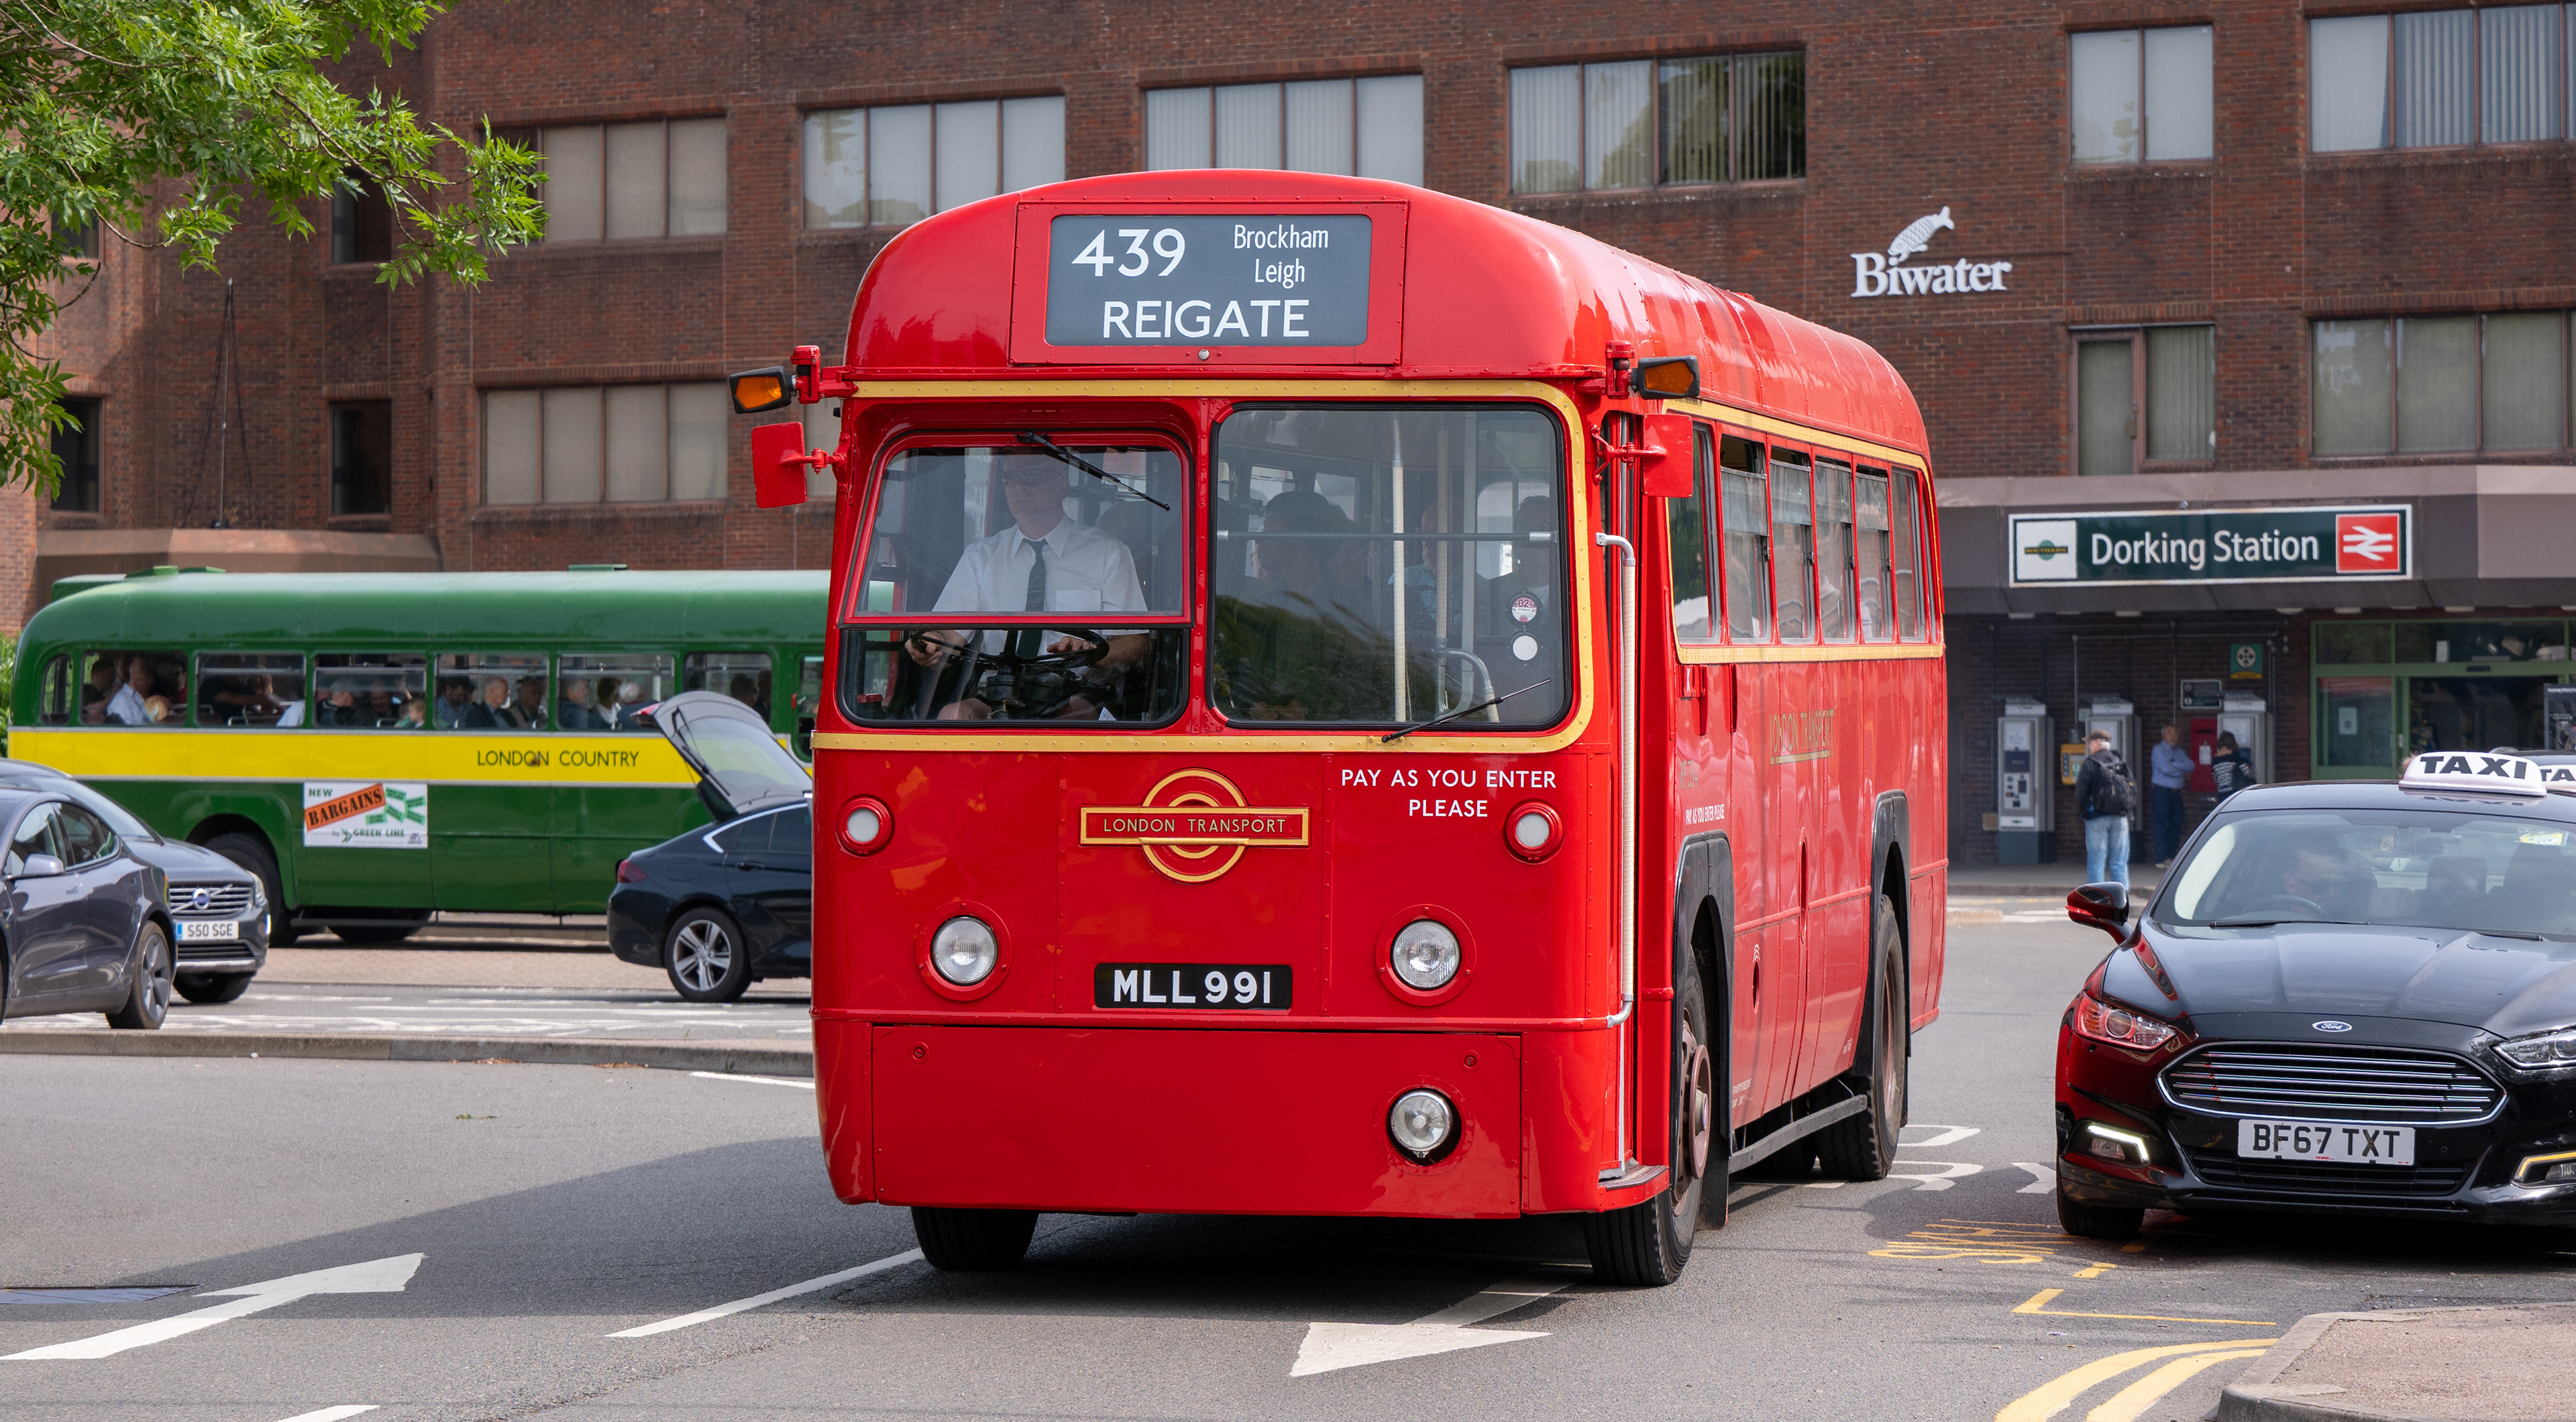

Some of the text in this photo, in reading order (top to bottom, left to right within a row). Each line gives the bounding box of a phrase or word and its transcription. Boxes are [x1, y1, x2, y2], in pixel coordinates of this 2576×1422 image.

[1071, 224, 1329, 277] 439 Brockham
[1254, 258, 1305, 290] Leigh
[1849, 252, 2013, 298] Biwater
[1103, 299, 1310, 339] REIGATE
[2092, 529, 2319, 571] Dorking Station
[1769, 708, 1834, 765] LONDON TRANSPORT
[477, 750, 639, 767] LONDON COUNTRY
[2420, 755, 2527, 779] TAXI
[1341, 769, 1557, 789] PAY AS YOU ENTER
[1680, 759, 1686, 790] RF
[307, 787, 383, 826] BARGAINS
[309, 788, 333, 796] NEW
[1409, 799, 1488, 817] PLEASE
[353, 828, 382, 837] GREEN
[386, 828, 405, 837] LINE
[1103, 818, 1286, 834] LONDON TRANSPORT
[188, 924, 233, 937] S50 SGE
[2253, 1124, 2400, 1158] BF67 TXT
